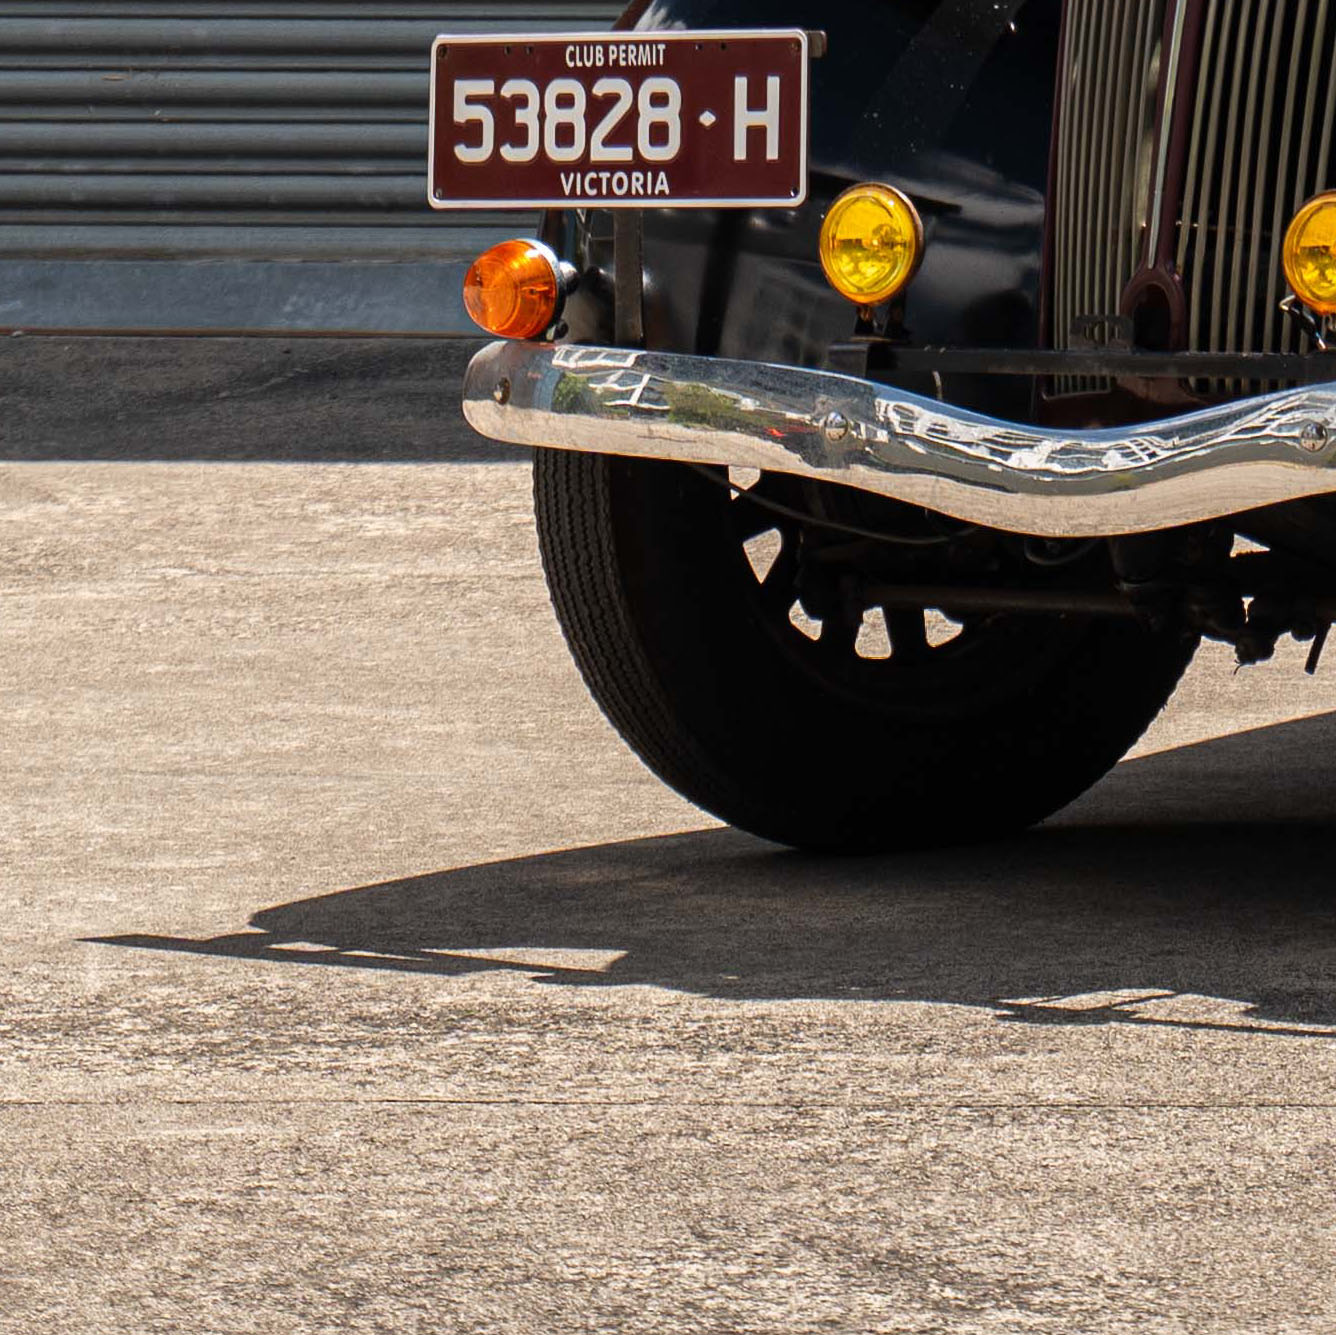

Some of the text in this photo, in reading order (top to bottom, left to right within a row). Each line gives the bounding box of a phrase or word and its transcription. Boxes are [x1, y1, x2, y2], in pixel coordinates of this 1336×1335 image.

[565, 43, 667, 68] CLUB PERMIT
[560, 171, 670, 196] VICTORIA
